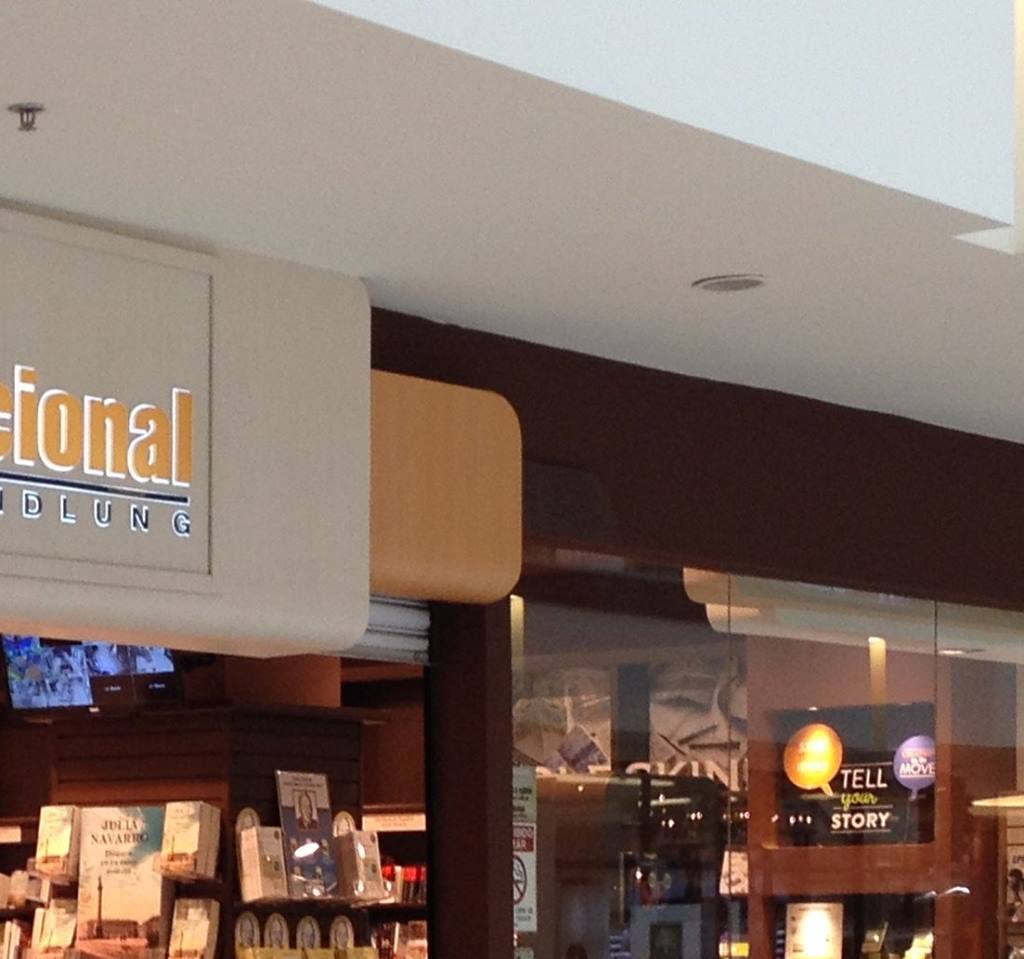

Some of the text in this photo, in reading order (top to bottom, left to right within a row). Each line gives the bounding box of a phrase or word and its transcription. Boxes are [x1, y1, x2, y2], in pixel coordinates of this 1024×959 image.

[841, 769, 888, 788] TELL
[841, 792, 878, 811] your
[831, 812, 890, 829] STORY
[91, 833, 149, 846] NAVARRO
